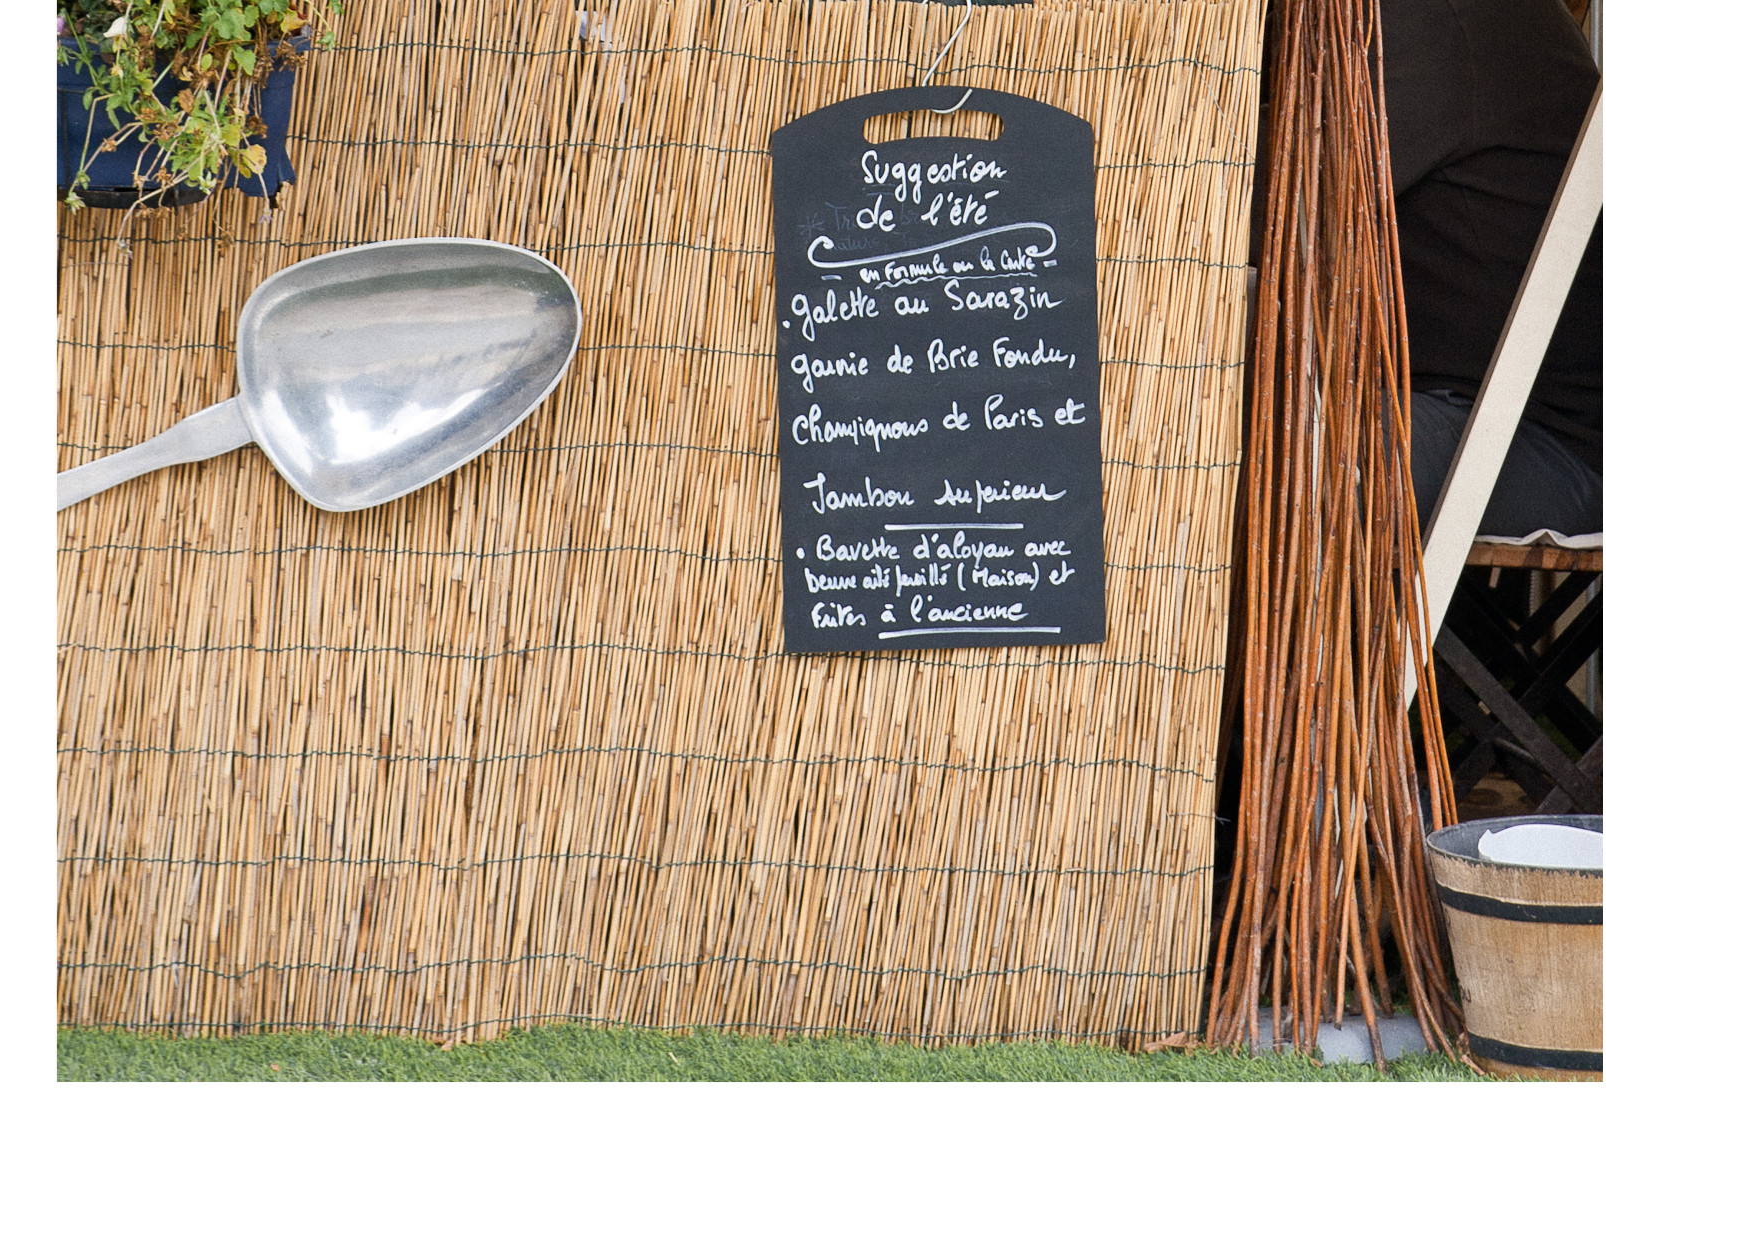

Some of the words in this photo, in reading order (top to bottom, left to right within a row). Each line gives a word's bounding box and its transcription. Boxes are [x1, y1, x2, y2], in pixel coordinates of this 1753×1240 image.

[861, 149, 1008, 204] Suggestion
[856, 194, 896, 232] de
[894, 295, 930, 316] au
[886, 344, 914, 375] de
[927, 338, 980, 374] Brie
[943, 401, 971, 431] de
[984, 394, 1044, 430] Paris
[1054, 397, 1086, 425] et
[816, 534, 900, 561] Bavette
[1024, 539, 1071, 558] avec
[1048, 561, 1075, 586] et
